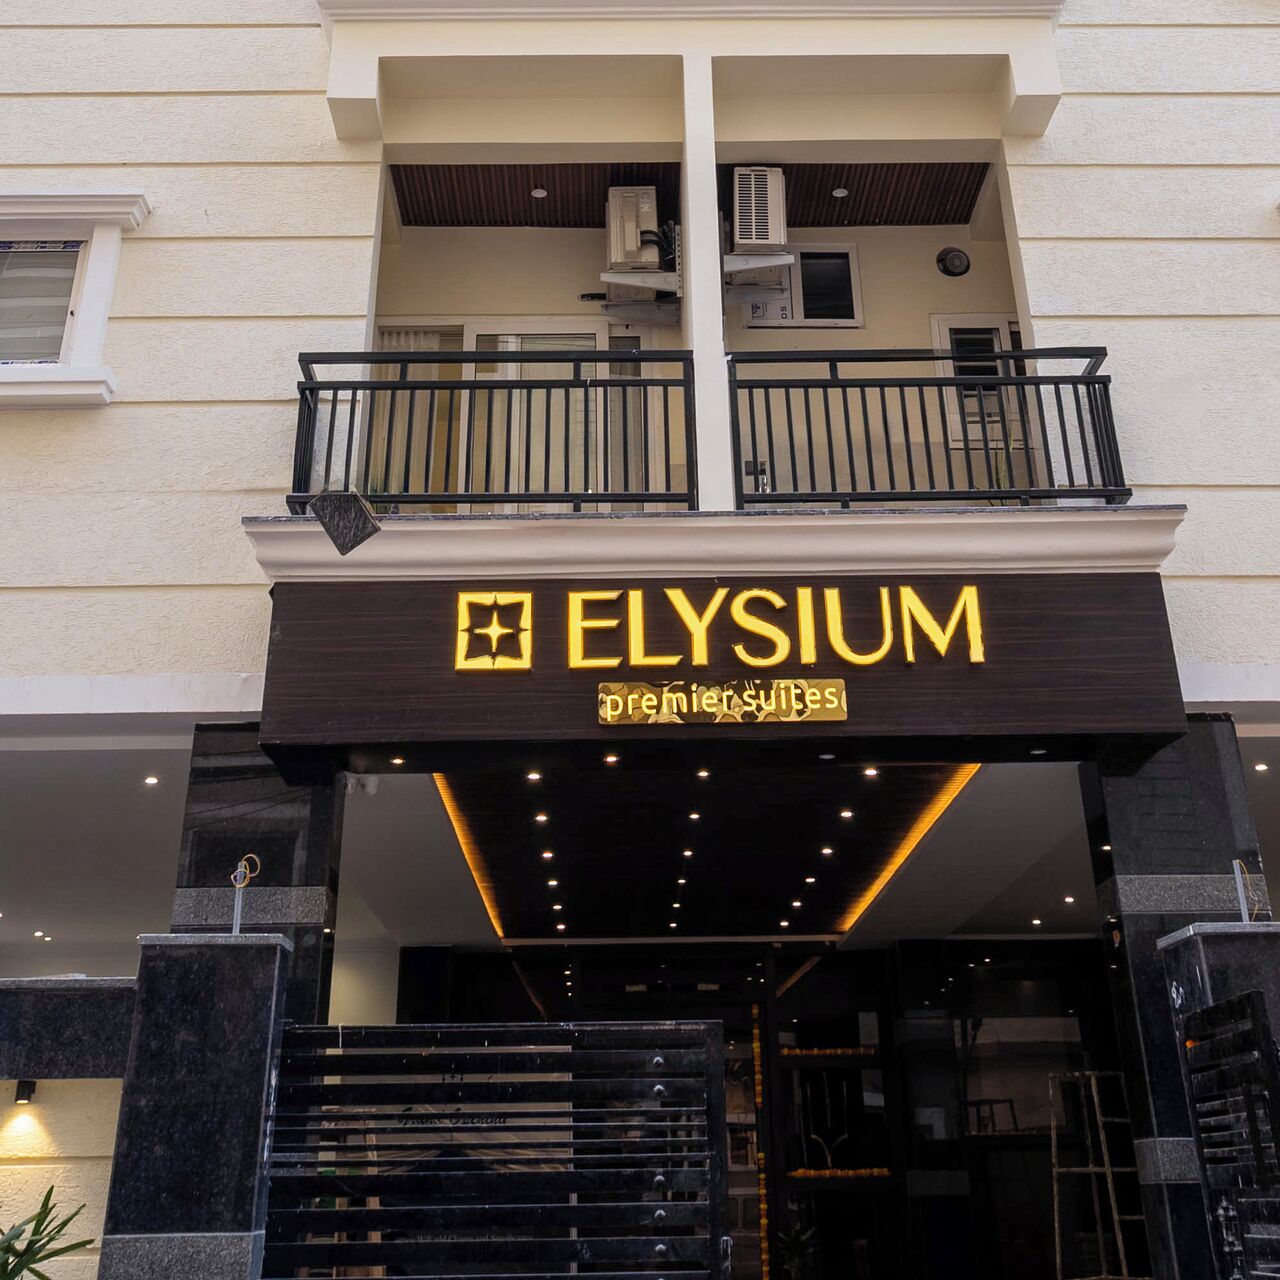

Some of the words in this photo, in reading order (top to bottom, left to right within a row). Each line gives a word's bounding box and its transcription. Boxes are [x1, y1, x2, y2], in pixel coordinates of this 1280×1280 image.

[568, 585, 986, 669] ELYSIUM
[606, 682, 734, 721] premier
[742, 682, 839, 711] suites
